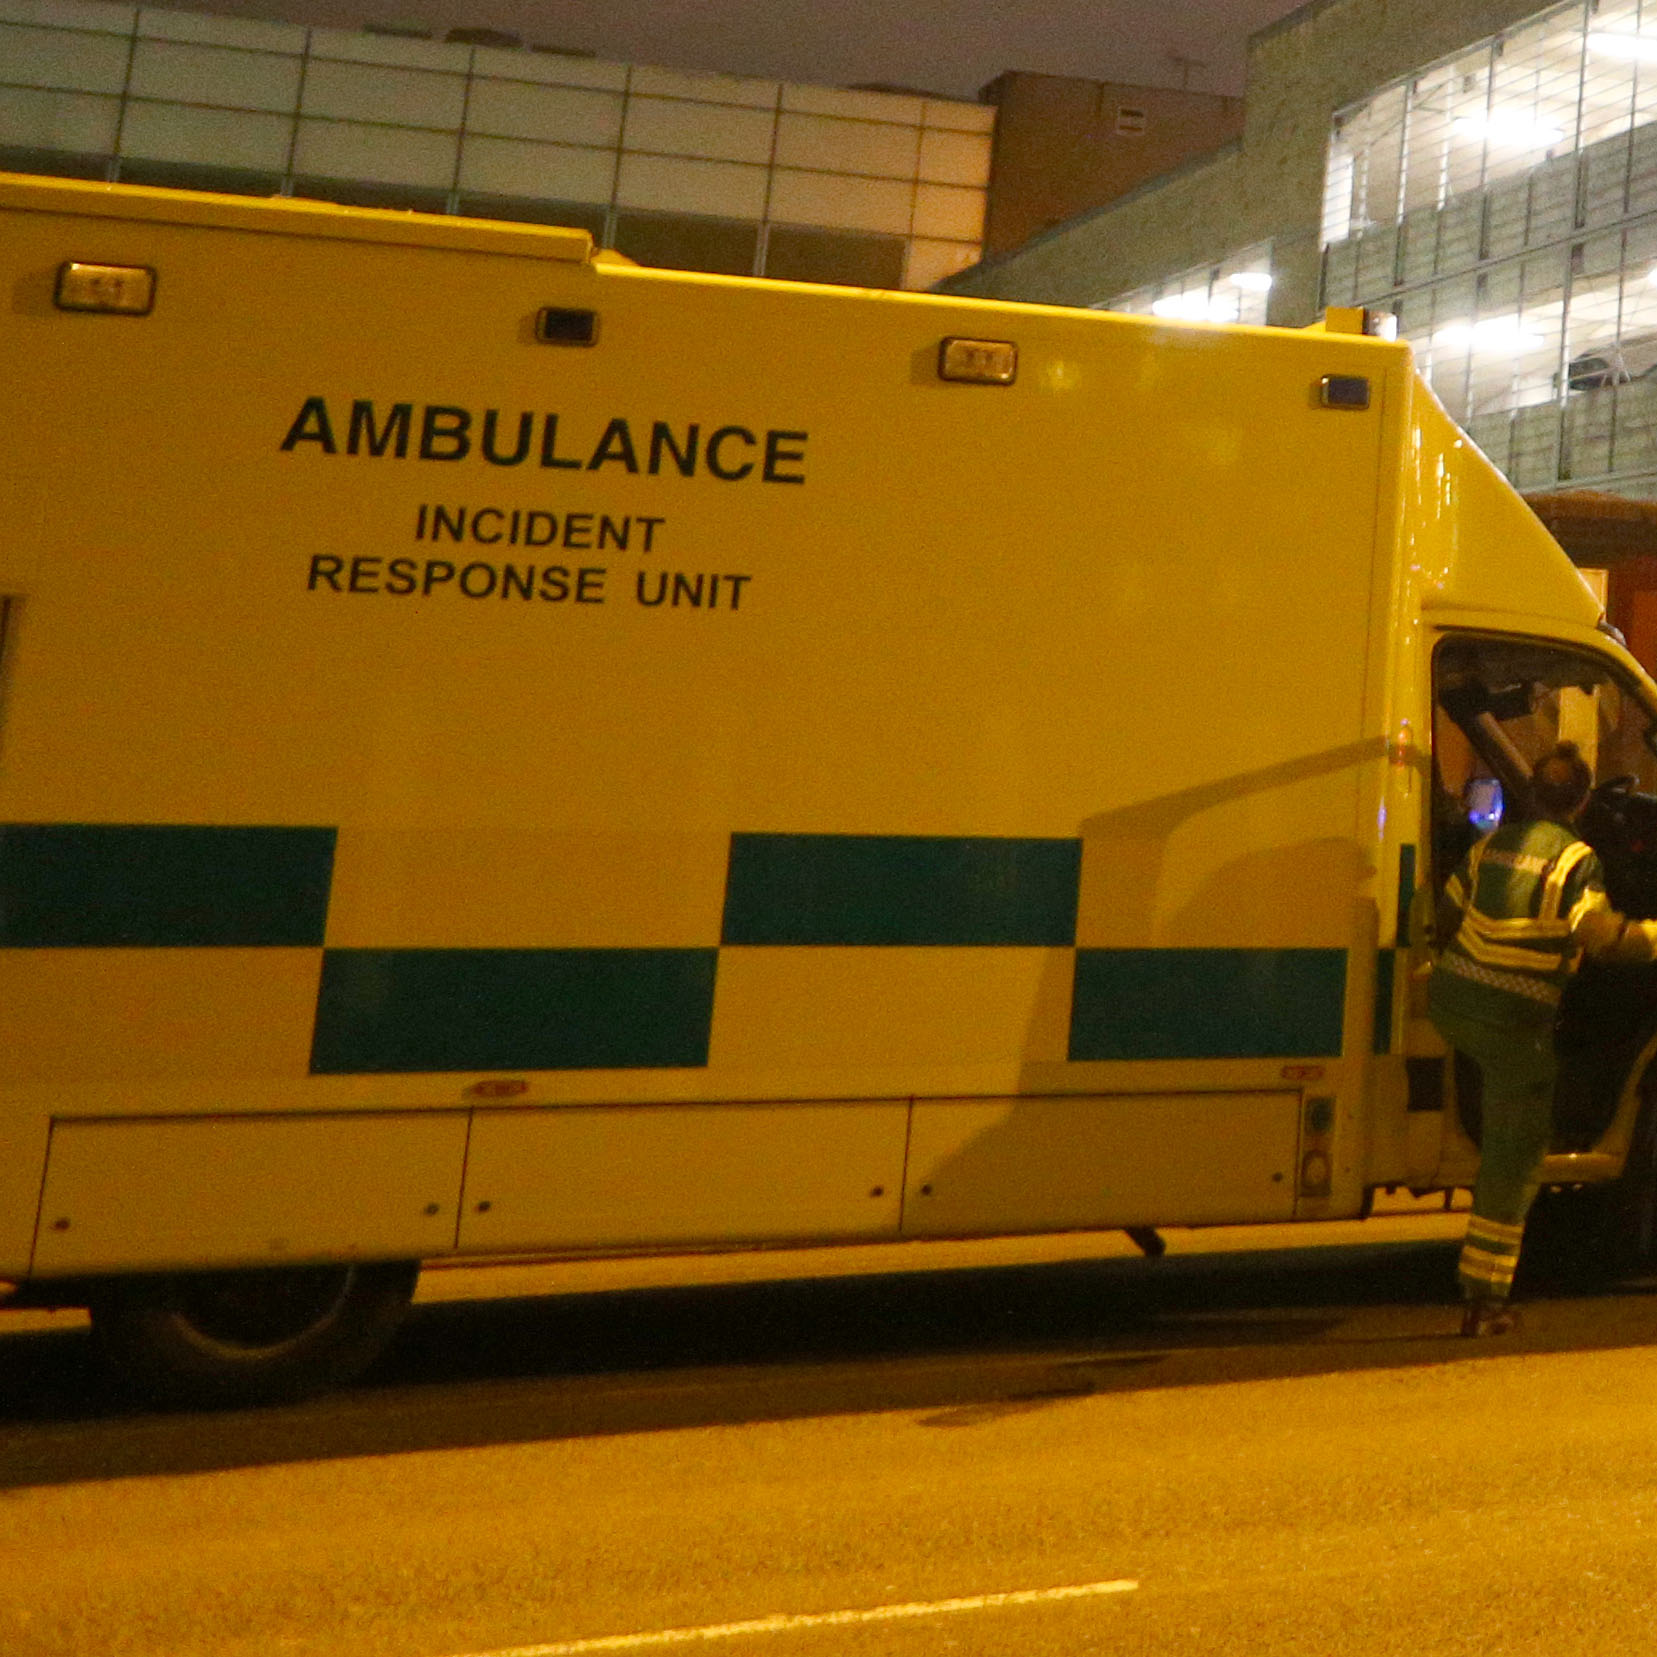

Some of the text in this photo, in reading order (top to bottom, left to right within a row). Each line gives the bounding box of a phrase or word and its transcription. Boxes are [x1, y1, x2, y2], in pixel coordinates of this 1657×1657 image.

[279, 395, 810, 485] AMBULANCE
[414, 502, 665, 553] INCIDENT
[306, 554, 752, 612] RESPONSE UNIT
